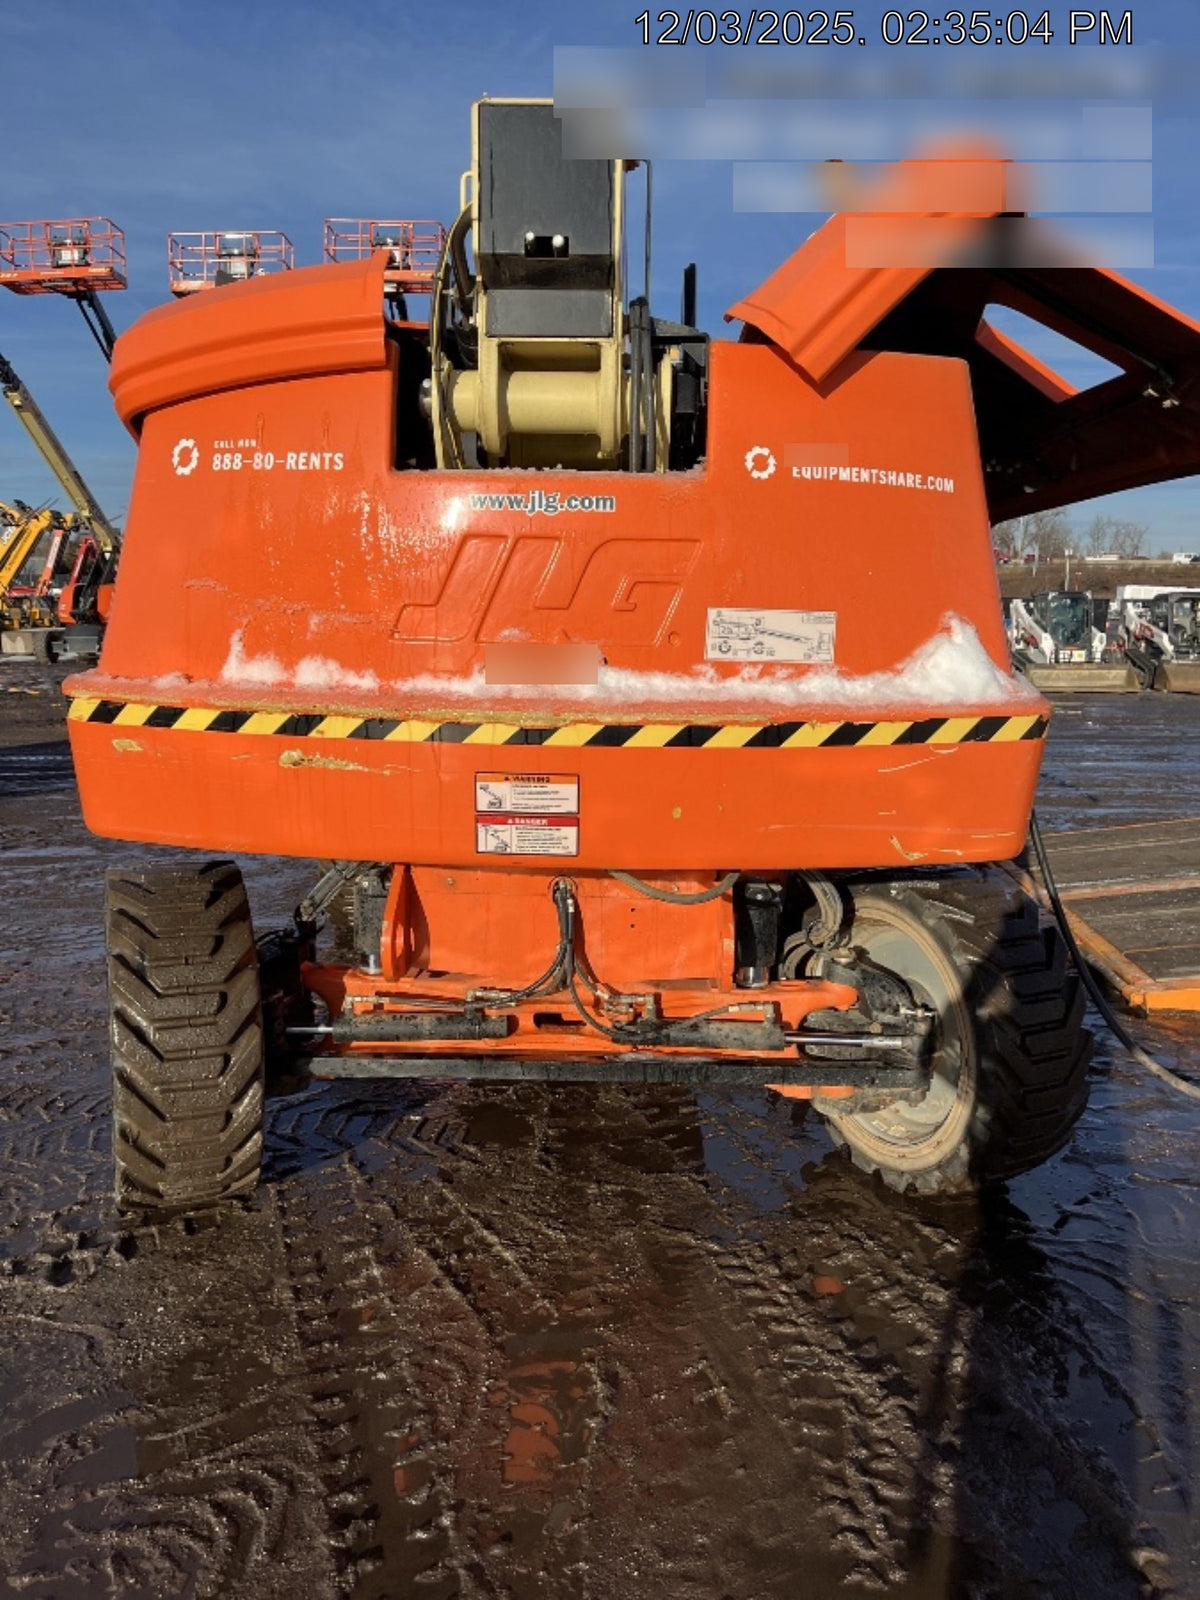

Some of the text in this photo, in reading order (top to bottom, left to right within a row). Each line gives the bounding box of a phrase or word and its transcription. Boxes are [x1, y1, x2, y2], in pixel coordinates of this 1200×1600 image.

[212, 452, 344, 471] 888-80-RENTS
[792, 466, 954, 493] EQUIPMENTSHARE.COM
[470, 490, 615, 515] www.jlg.com
[389, 534, 703, 647] JLG
[515, 817, 548, 826] DANGER
